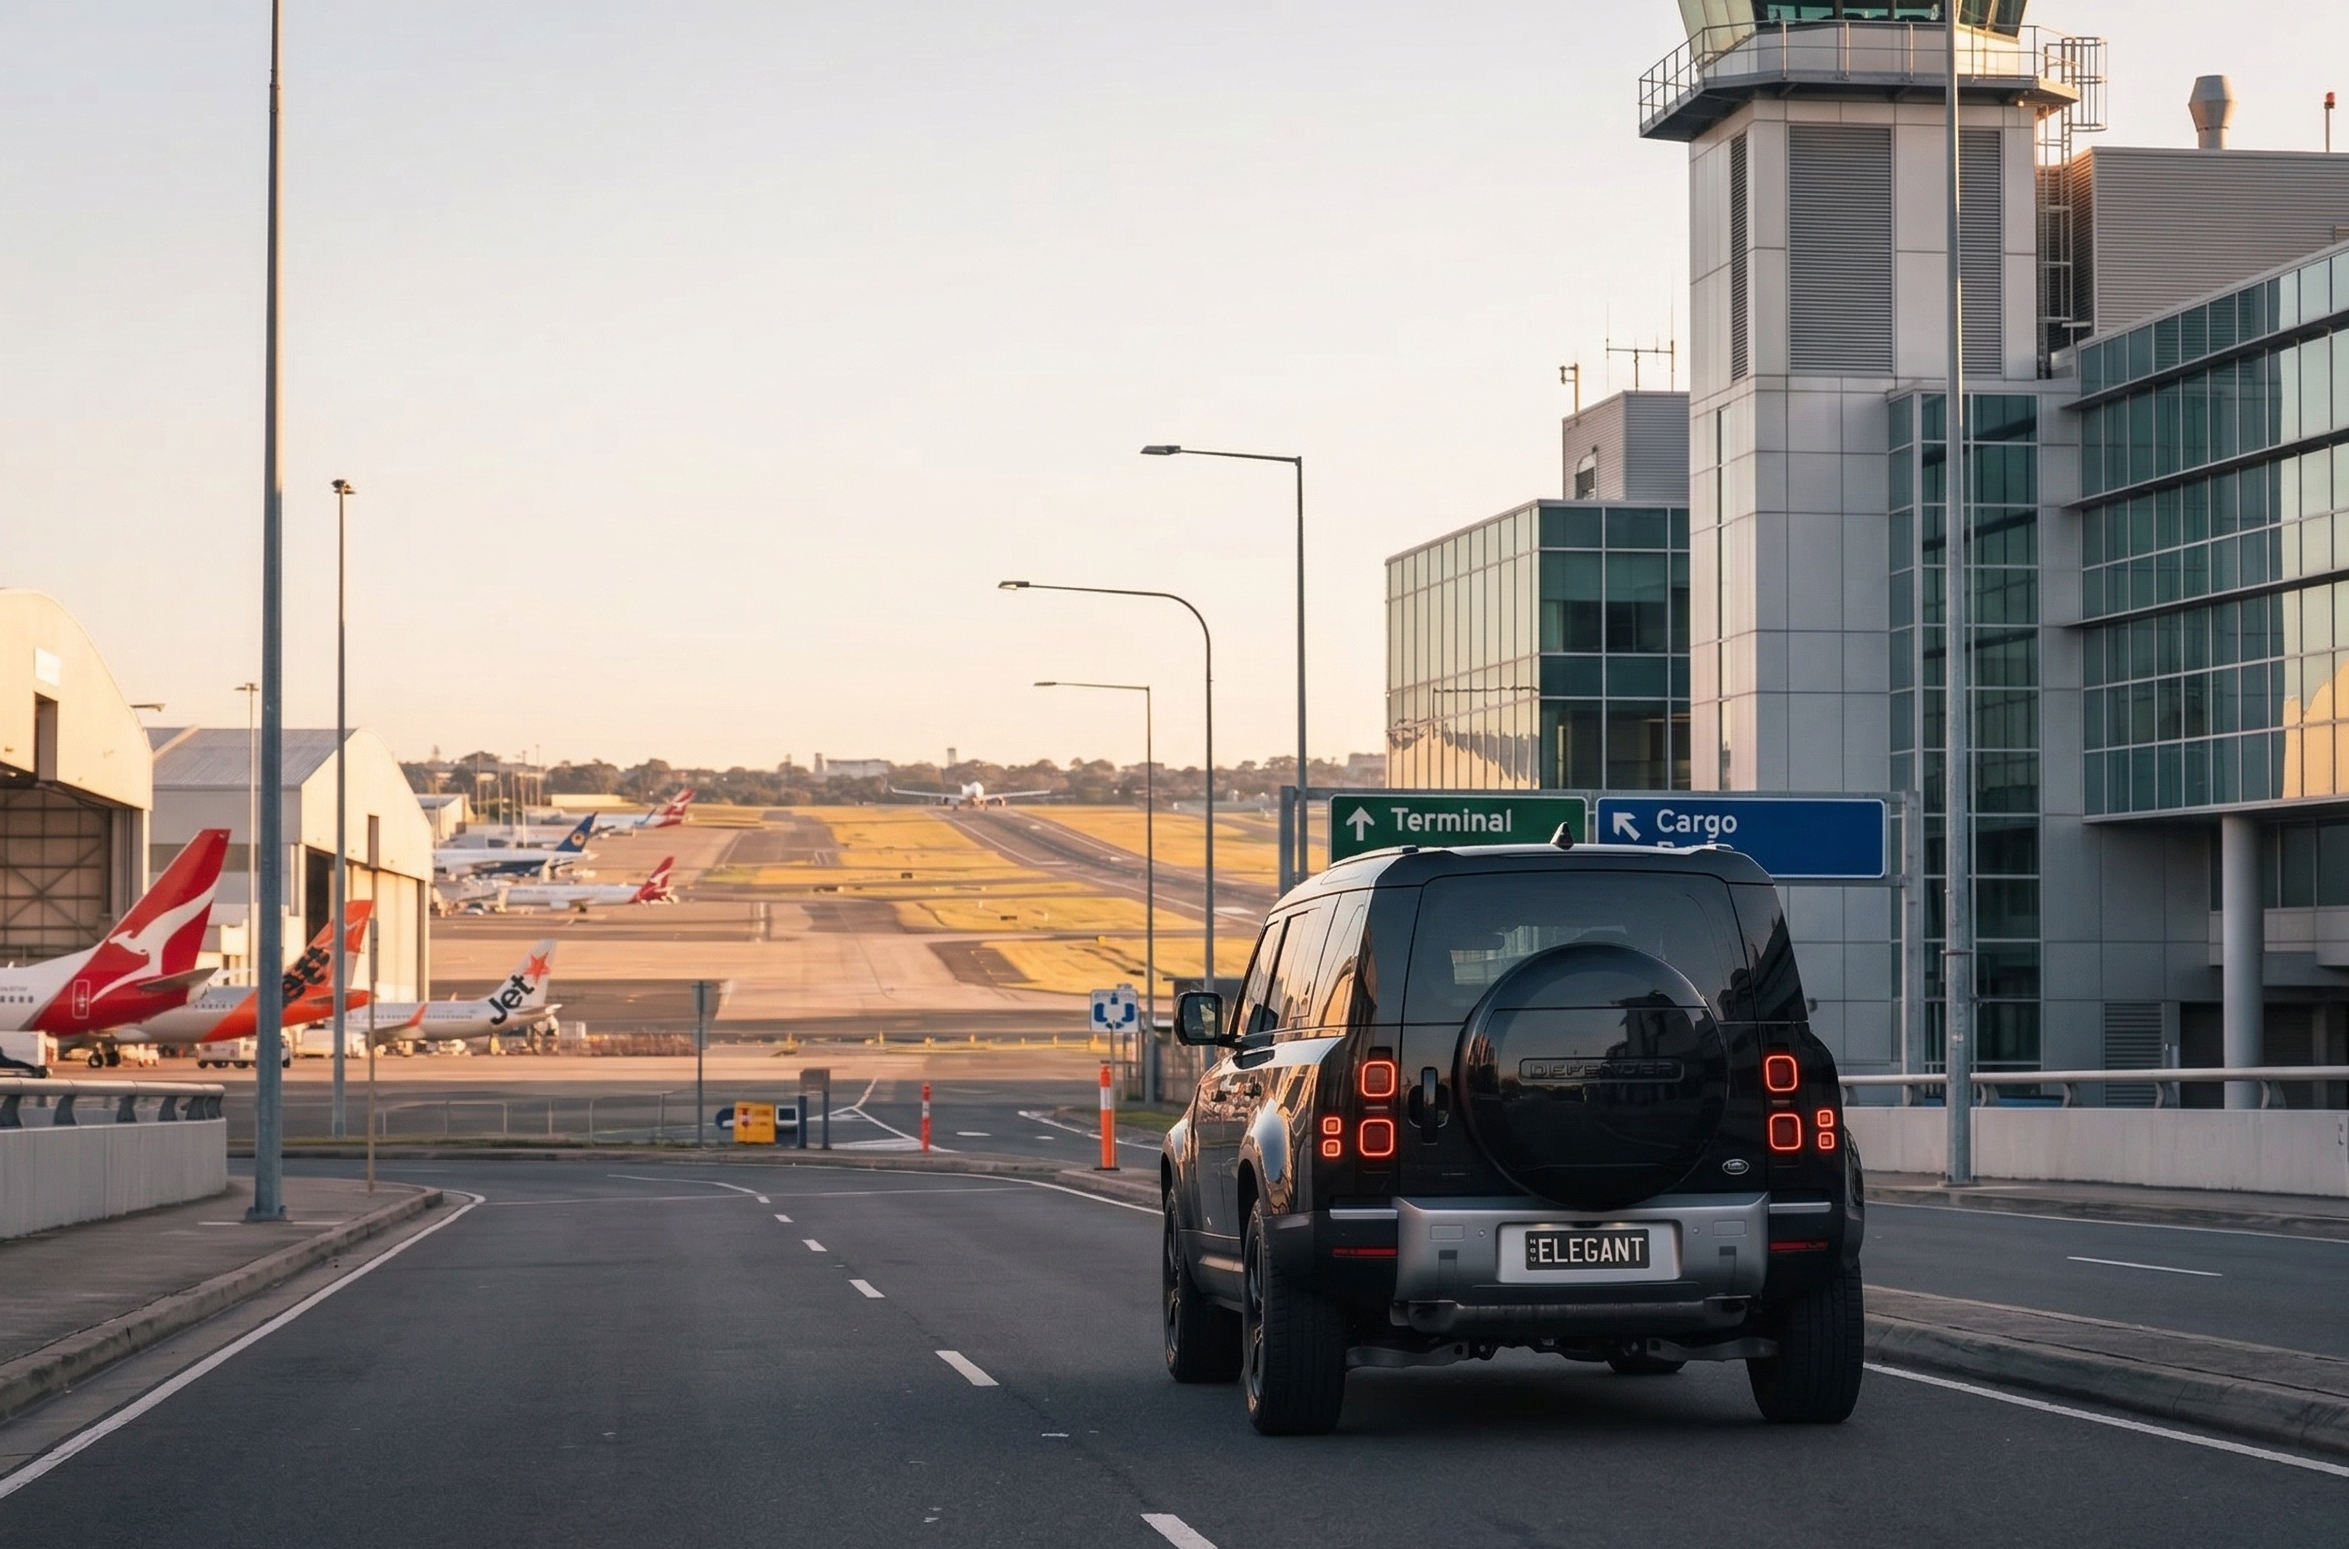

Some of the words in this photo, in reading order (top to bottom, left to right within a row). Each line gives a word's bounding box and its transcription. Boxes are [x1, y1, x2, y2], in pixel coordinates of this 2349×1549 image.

[1391, 807, 1512, 832] Terminal
[1657, 808, 1738, 839] Cargo
[488, 974, 535, 1025] Jet
[1538, 1237, 1645, 1263] ELEGANT
